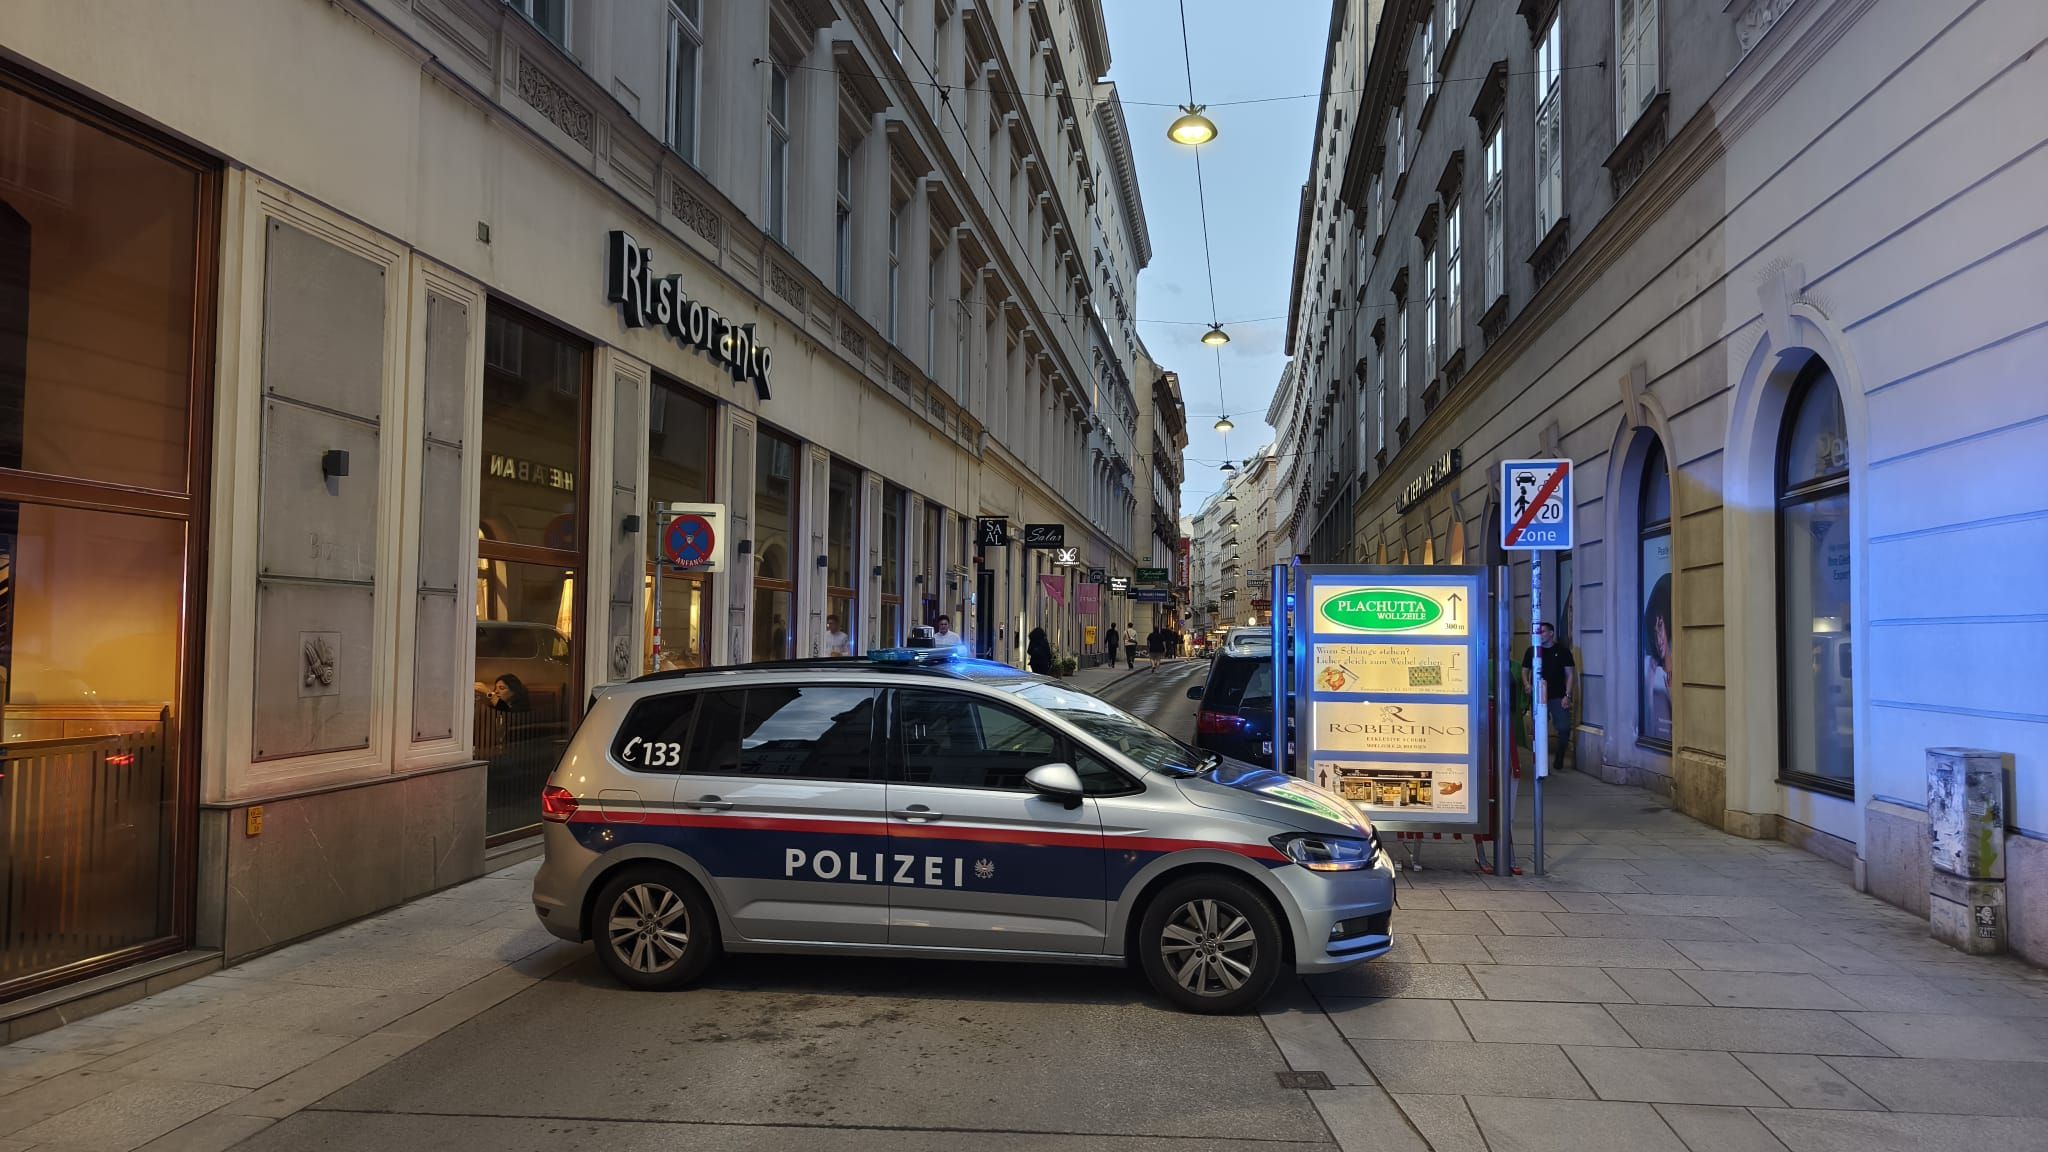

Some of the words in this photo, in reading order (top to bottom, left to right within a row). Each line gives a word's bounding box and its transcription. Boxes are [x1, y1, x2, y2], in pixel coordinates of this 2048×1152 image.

[609, 230, 773, 400] Ristorante
[1541, 503, 1560, 520] 20
[1517, 528, 1557, 542] Zone
[675, 556, 704, 568] ANFANG
[1338, 600, 1426, 613] PLACHUTTA
[1377, 612, 1427, 621] WOLLZEILE
[1341, 645, 1377, 656] Schlange
[1379, 646, 1410, 655] stehen?
[1329, 723, 1465, 736] ROBERTINO
[642, 741, 681, 767] 133
[784, 848, 964, 887] POLIZEI
